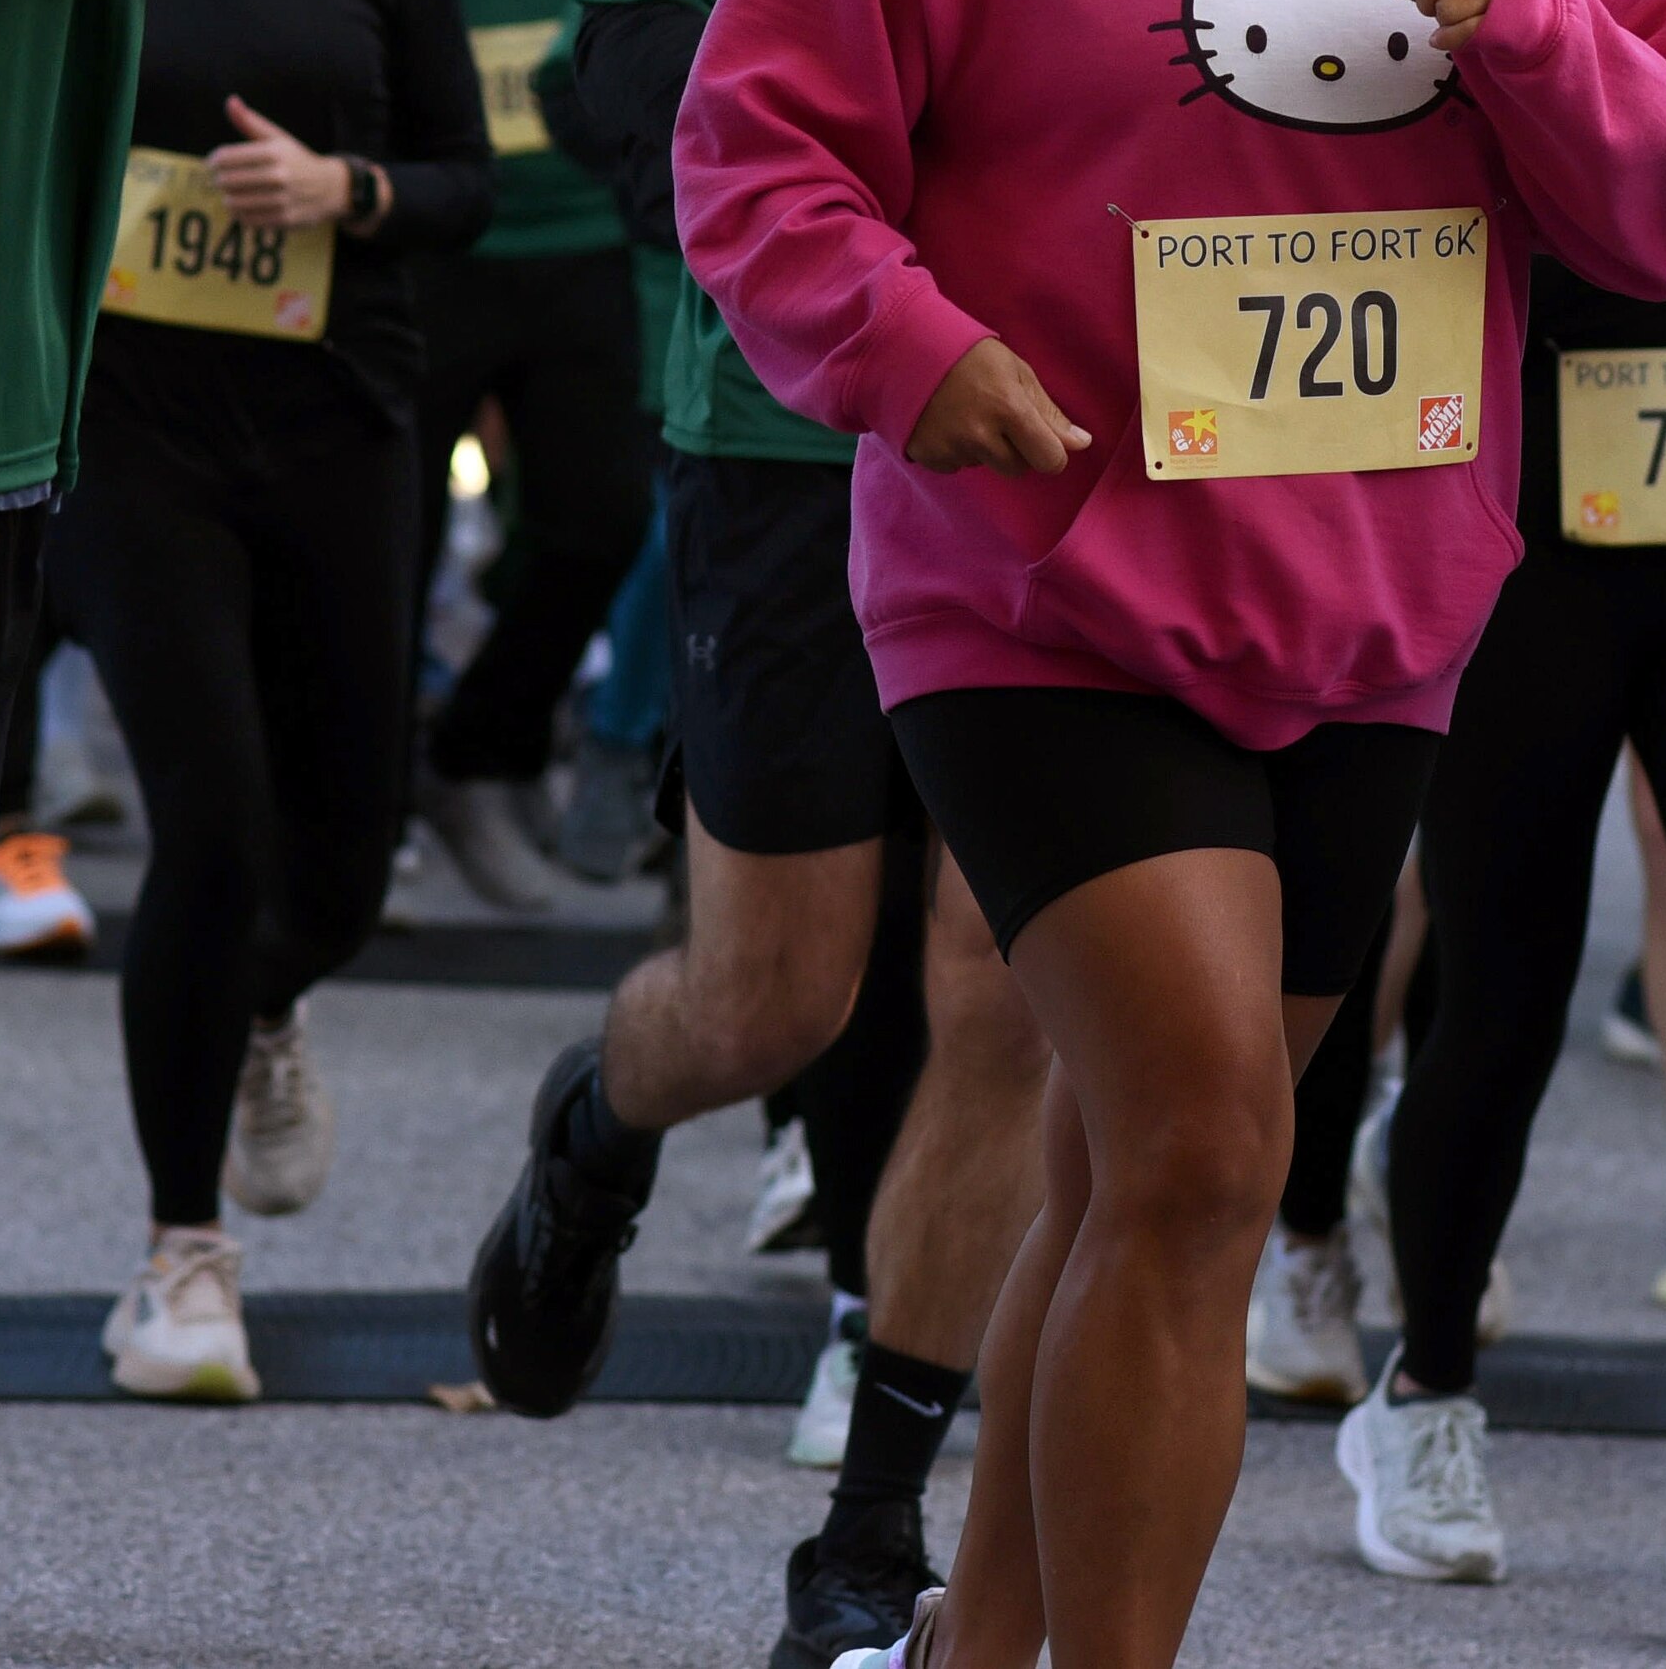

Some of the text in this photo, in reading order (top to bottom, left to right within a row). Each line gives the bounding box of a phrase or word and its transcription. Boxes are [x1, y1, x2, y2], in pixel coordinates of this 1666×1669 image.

[147, 207, 285, 286] 1948
[1158, 223, 1476, 269] PORT TO FORT 6K
[1238, 289, 1398, 401] 720
[1576, 361, 1649, 389] PORT
[1420, 394, 1463, 450] HOME
[1424, 402, 1443, 425] THE
